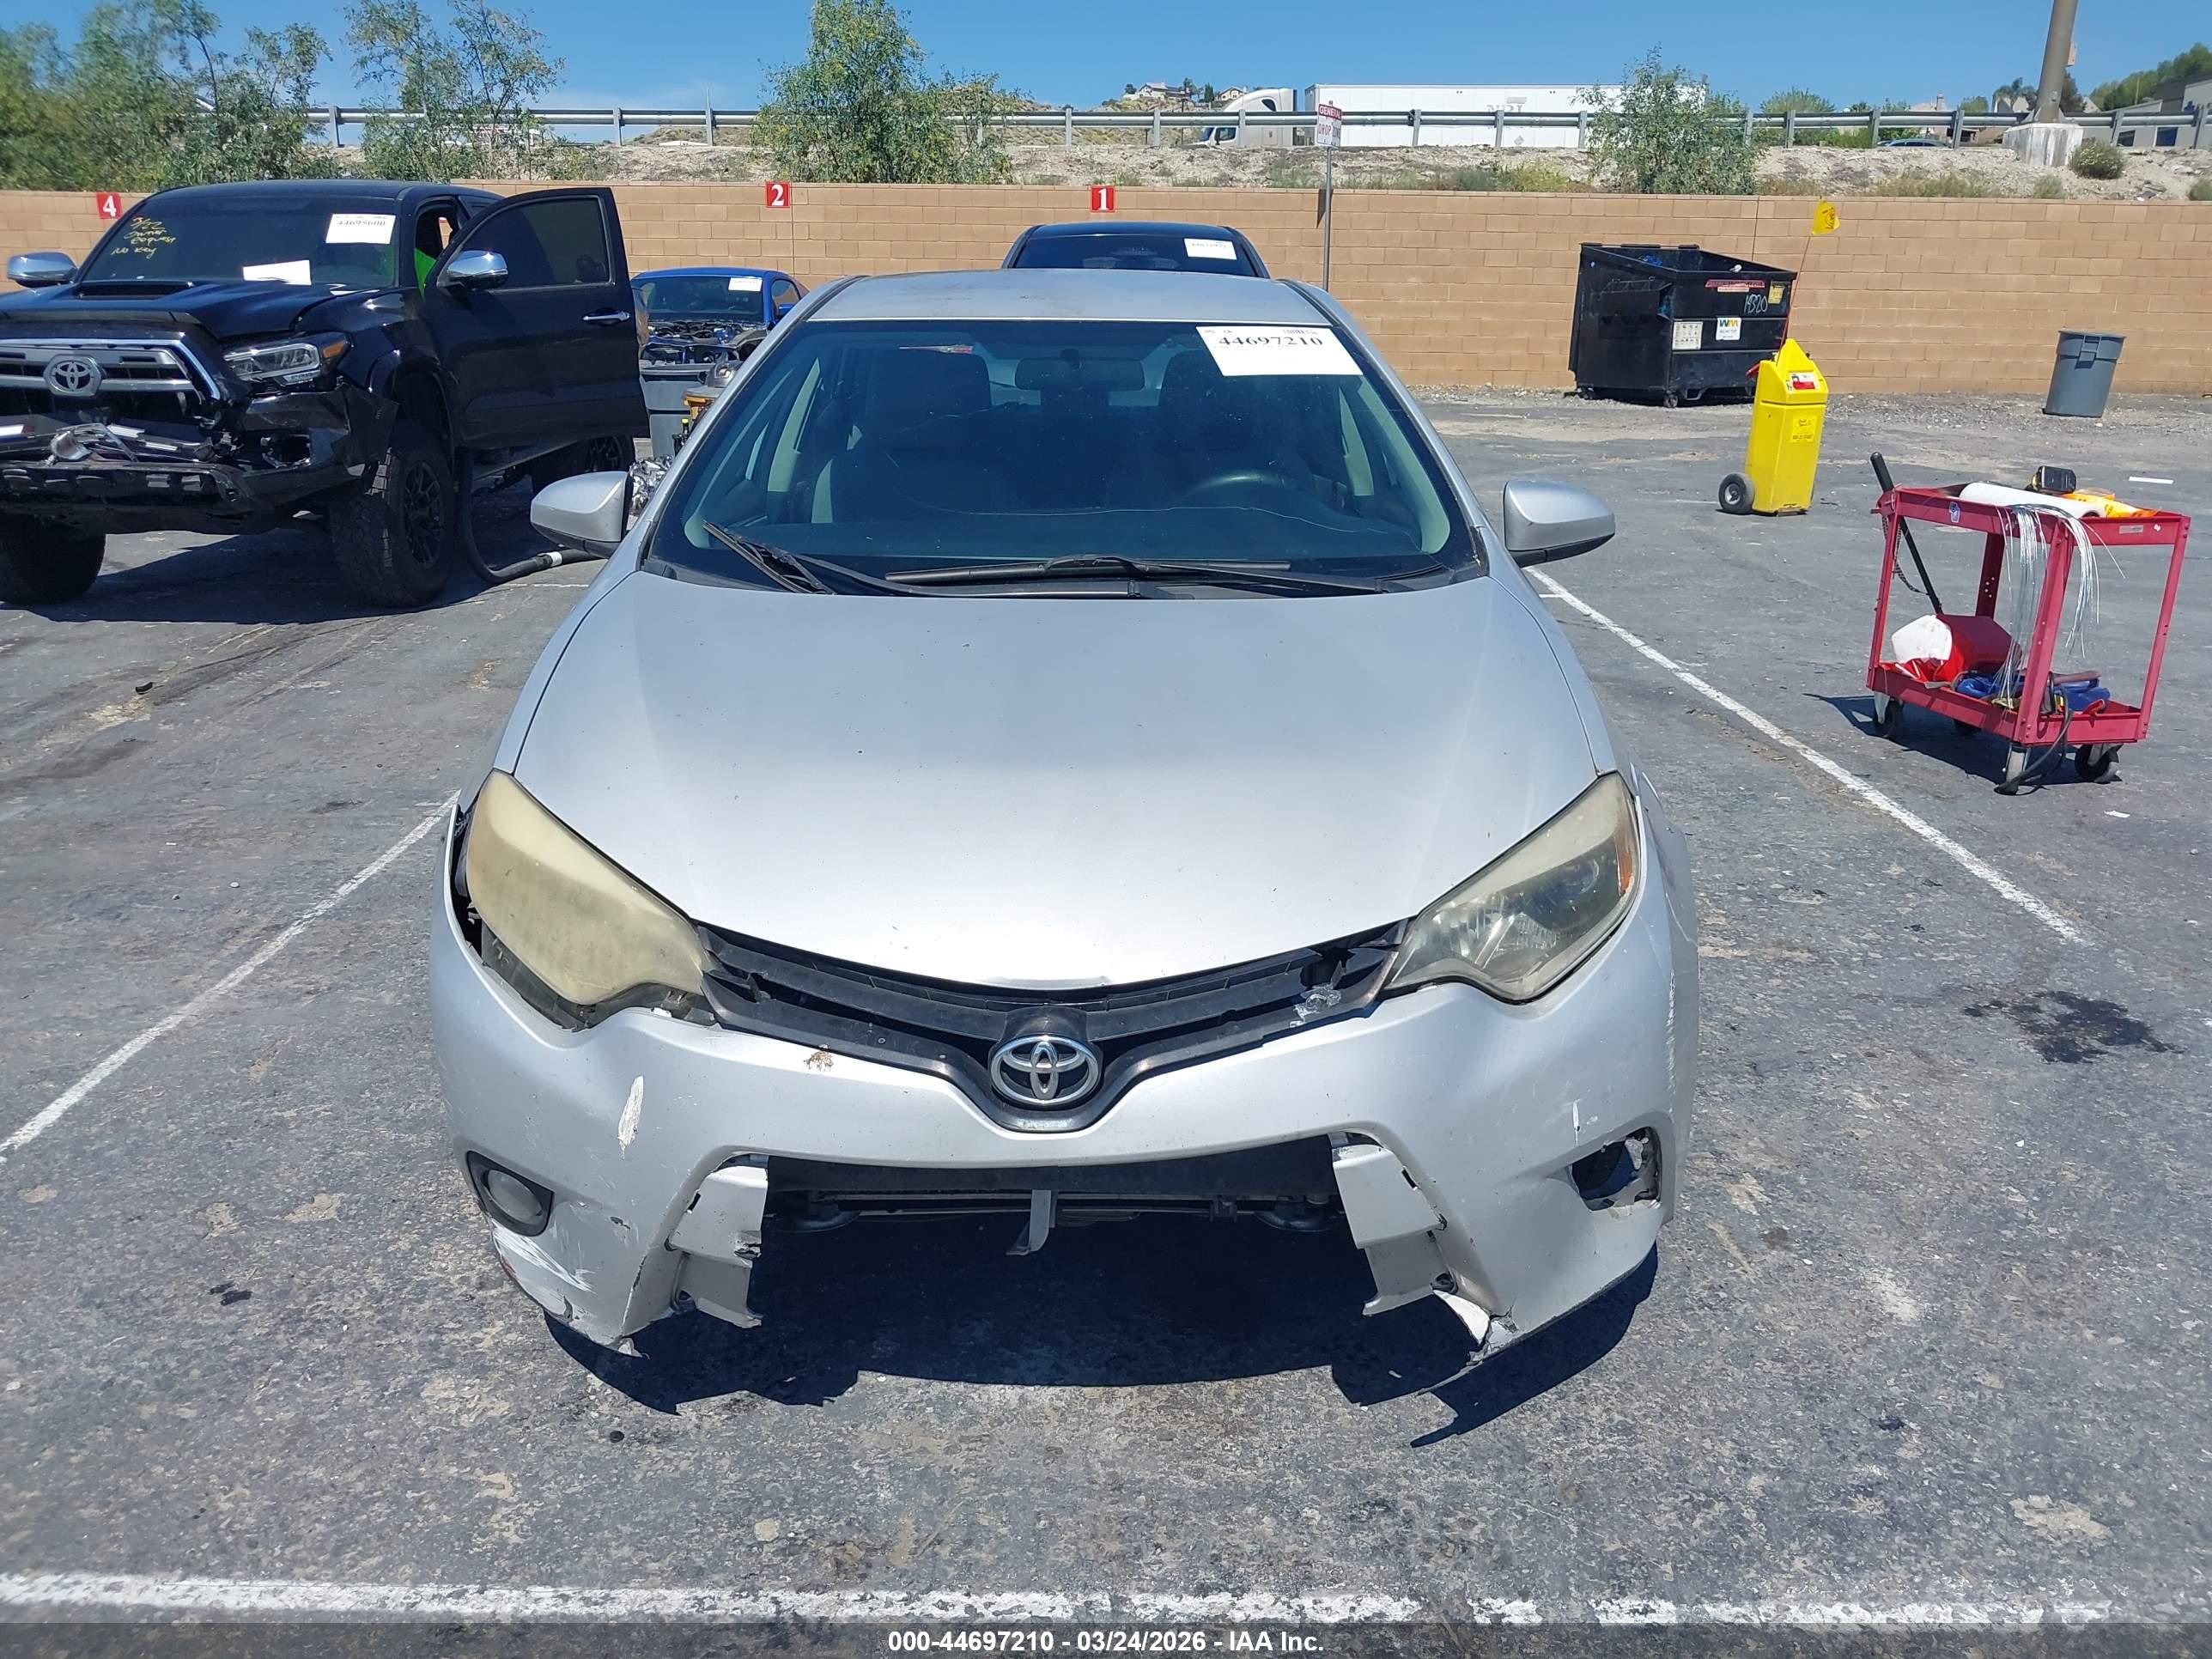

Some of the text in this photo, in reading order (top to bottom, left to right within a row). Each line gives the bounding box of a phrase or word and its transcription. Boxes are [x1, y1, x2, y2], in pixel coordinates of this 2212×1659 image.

[1319, 106, 1340, 118] GENERAL
[1318, 124, 1331, 136] DROP
[771, 184, 785, 206] 2
[1098, 187, 1109, 210] 1
[103, 195, 117, 216] 4
[1719, 319, 1739, 327] WM
[1218, 336, 1323, 346] 44697210
